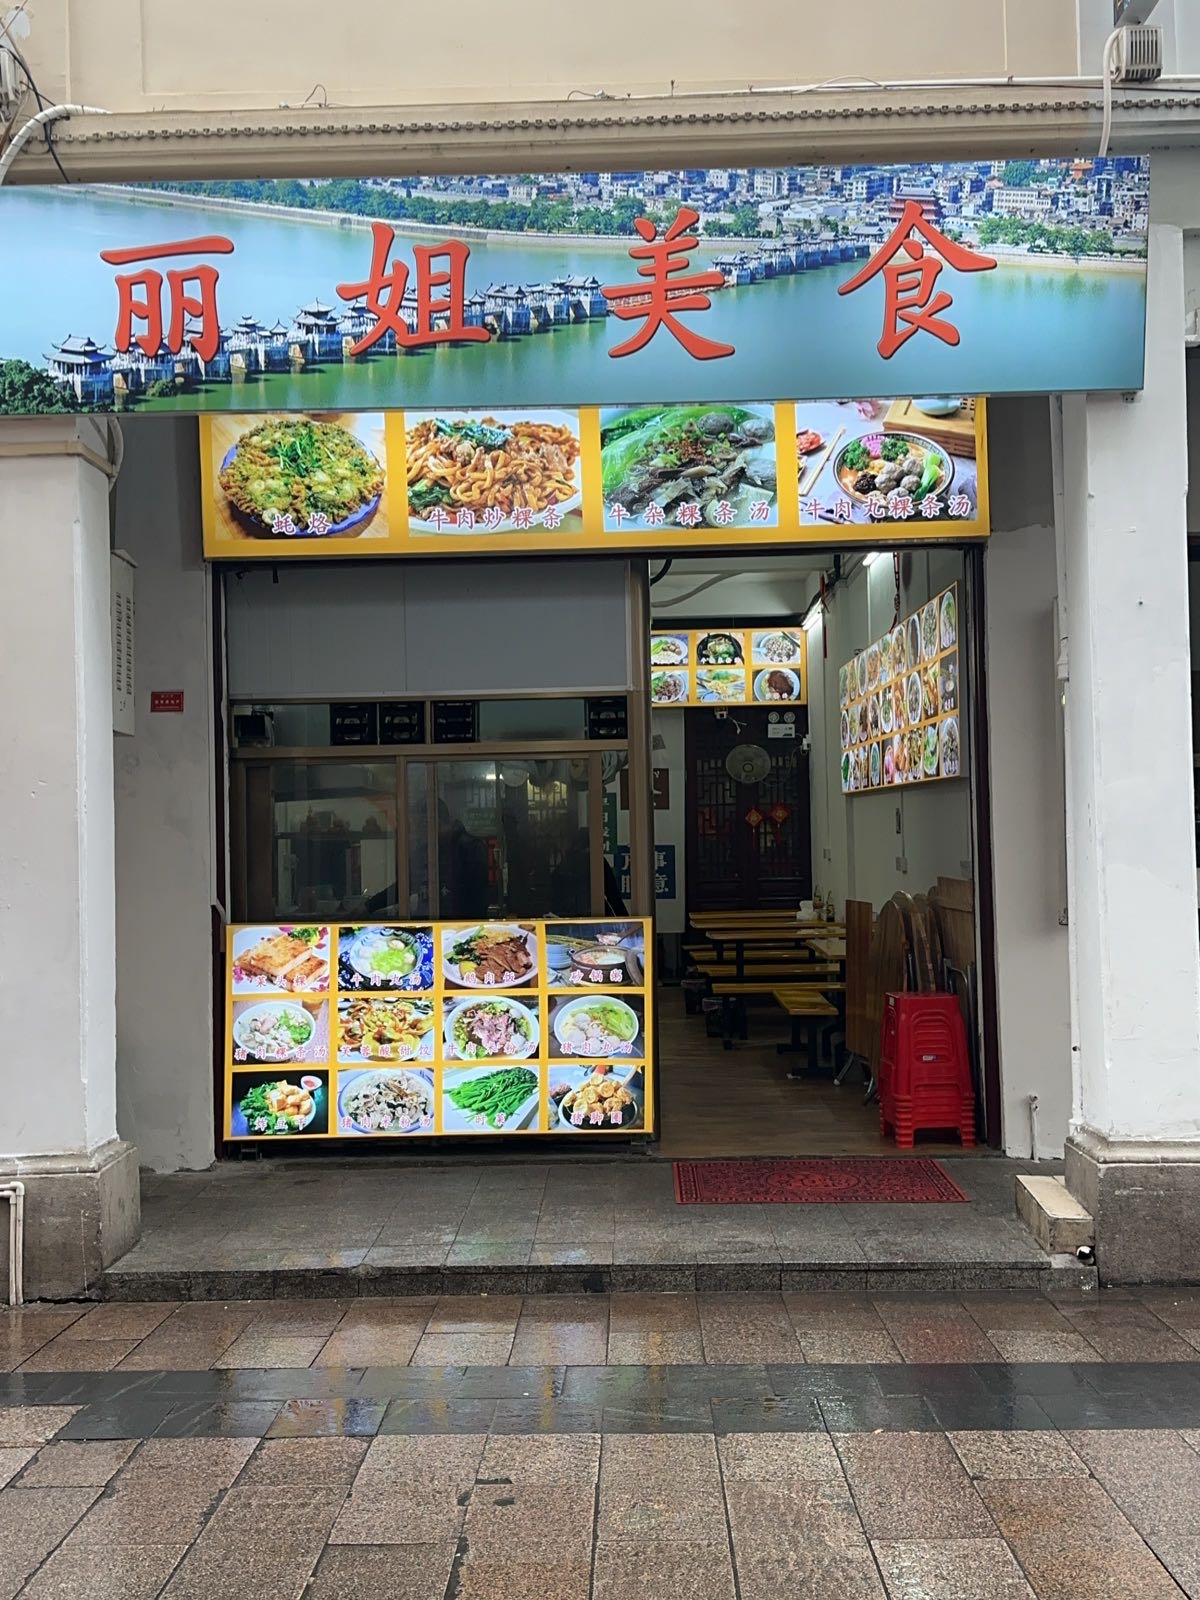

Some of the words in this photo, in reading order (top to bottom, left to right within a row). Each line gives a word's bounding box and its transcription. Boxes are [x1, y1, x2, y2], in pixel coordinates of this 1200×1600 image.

[100, 199, 997, 363] 丽姐美食
[609, 501, 771, 527] 牛杂粿条汤
[805, 494, 972, 520] 牛肉丸粿条汤
[273, 513, 331, 535] 蚝烙
[429, 507, 564, 531] 牛肉炒粿条
[255, 974, 306, 987] 菜头粿
[350, 972, 422, 988] 牛肉丸汤
[569, 969, 623, 983] 砂锅粥
[234, 1045, 327, 1060] 猪肉粿条汤
[560, 1040, 632, 1054] 猪肉丸汤
[255, 1116, 306, 1131] 炸豆干
